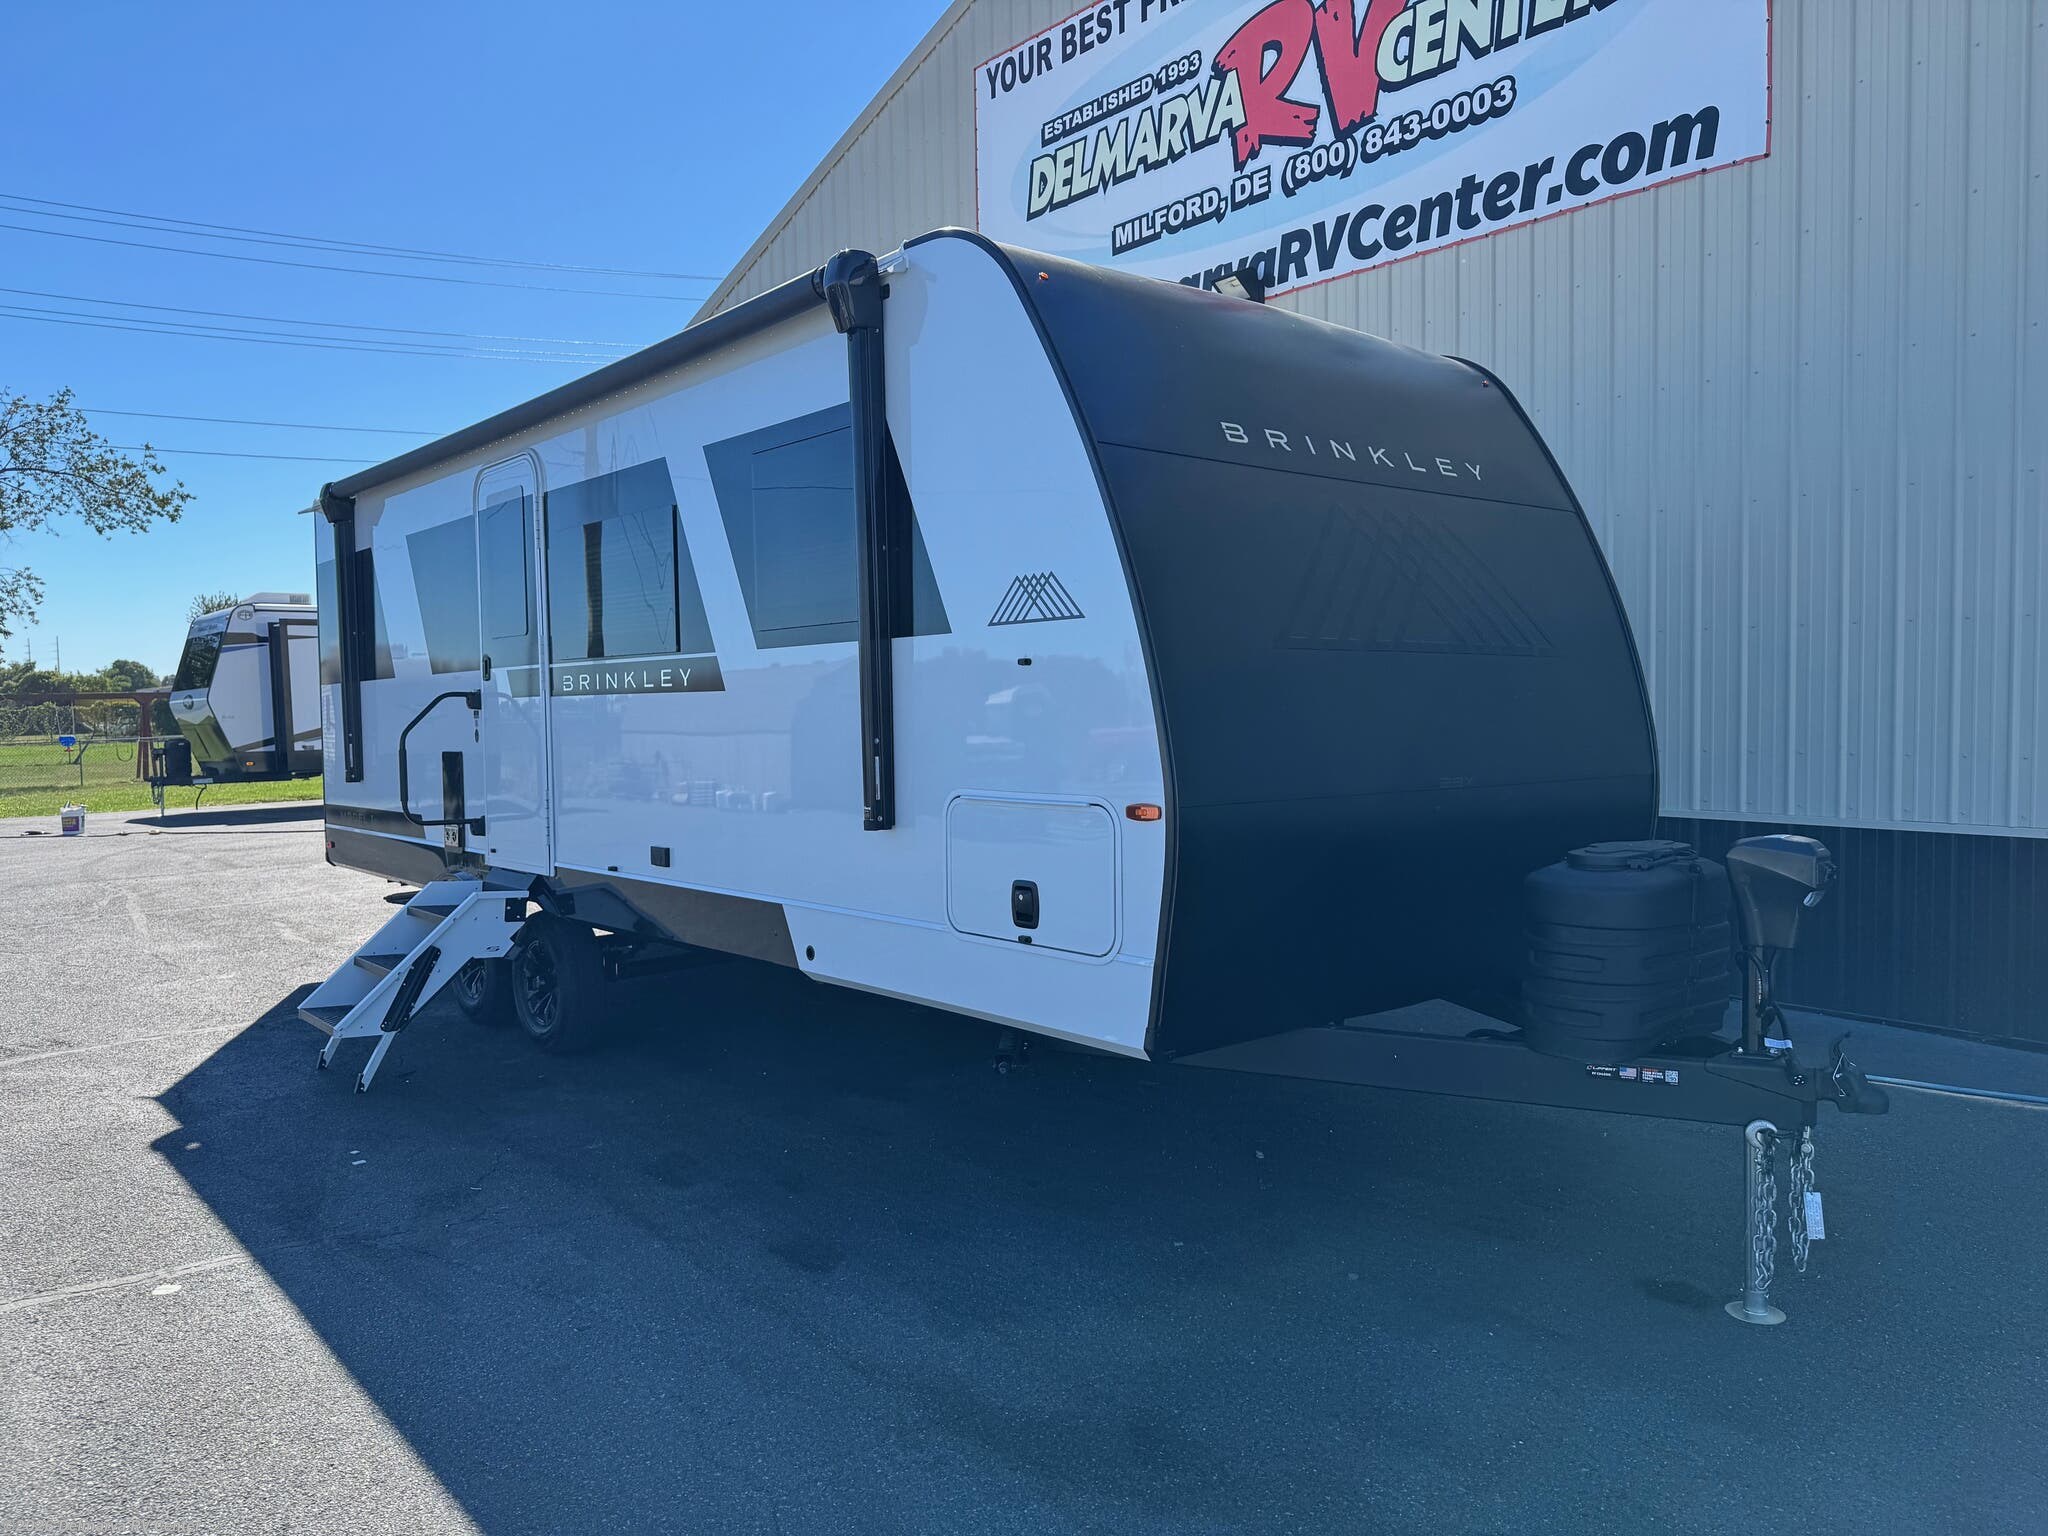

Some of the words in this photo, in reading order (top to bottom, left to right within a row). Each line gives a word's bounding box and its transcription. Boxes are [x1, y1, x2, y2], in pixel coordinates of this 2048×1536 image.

[986, 37, 1053, 99] YOUR
[1062, 0, 1130, 64] BEST
[1042, 75, 1154, 144] ESTABLISHED
[1157, 51, 1202, 90] 1993
[1027, 69, 1248, 219] DELMARVA
[1214, 0, 1405, 165] RV
[1113, 188, 1227, 252] MILFORD,
[1233, 168, 1271, 206] DE
[1284, 135, 1358, 191] (800)
[1364, 79, 1516, 157] 843-0003
[1220, 421, 1482, 481] BRINKLEY
[562, 668, 692, 692] BRINKLEY
